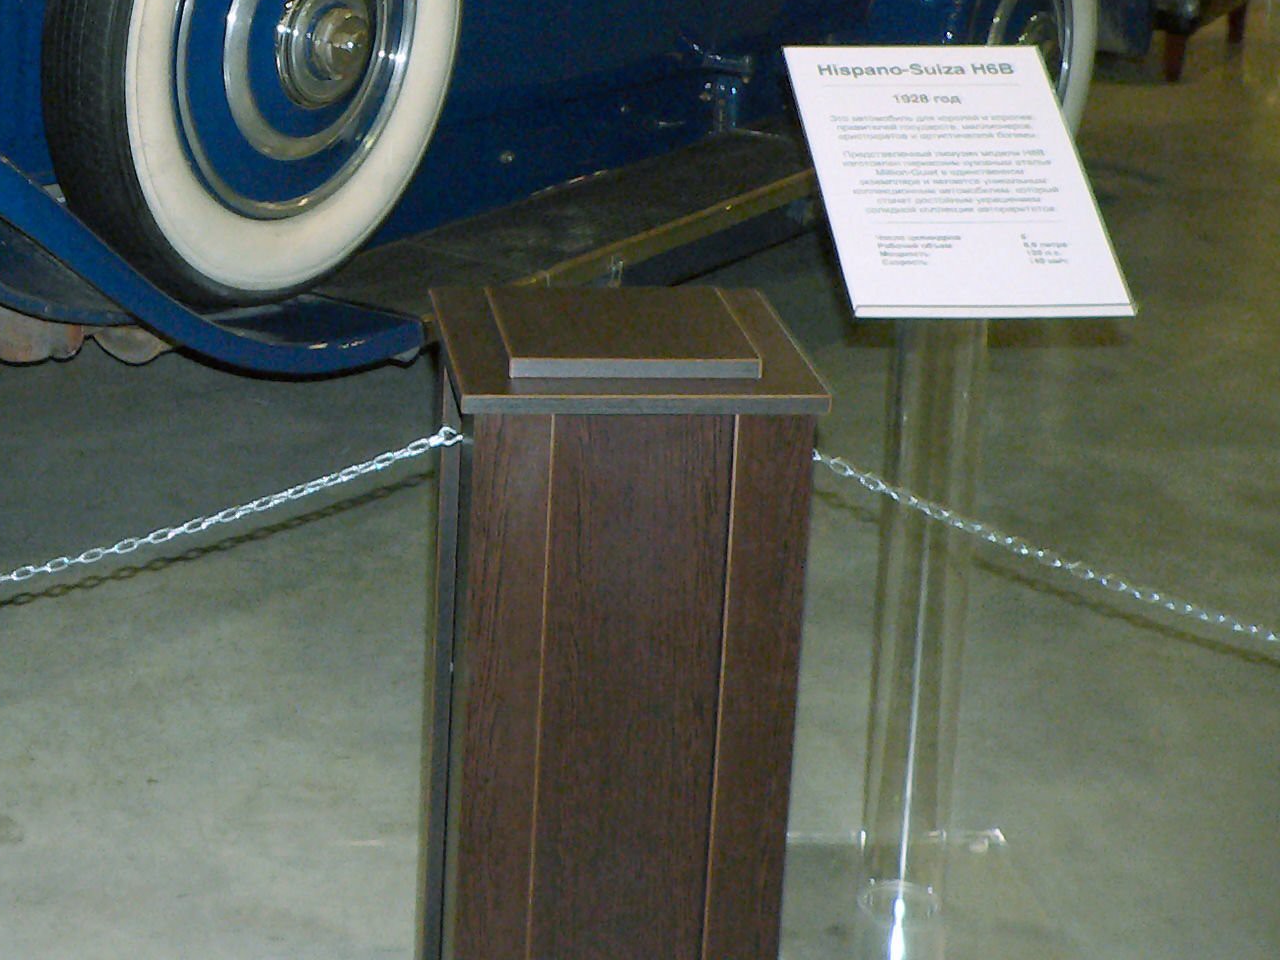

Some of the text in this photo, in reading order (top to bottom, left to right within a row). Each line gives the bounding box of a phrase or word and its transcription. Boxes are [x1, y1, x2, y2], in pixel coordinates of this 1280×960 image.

[817, 62, 1015, 79] Hispano-Suiza H6B
[892, 93, 963, 105] 1928 год
